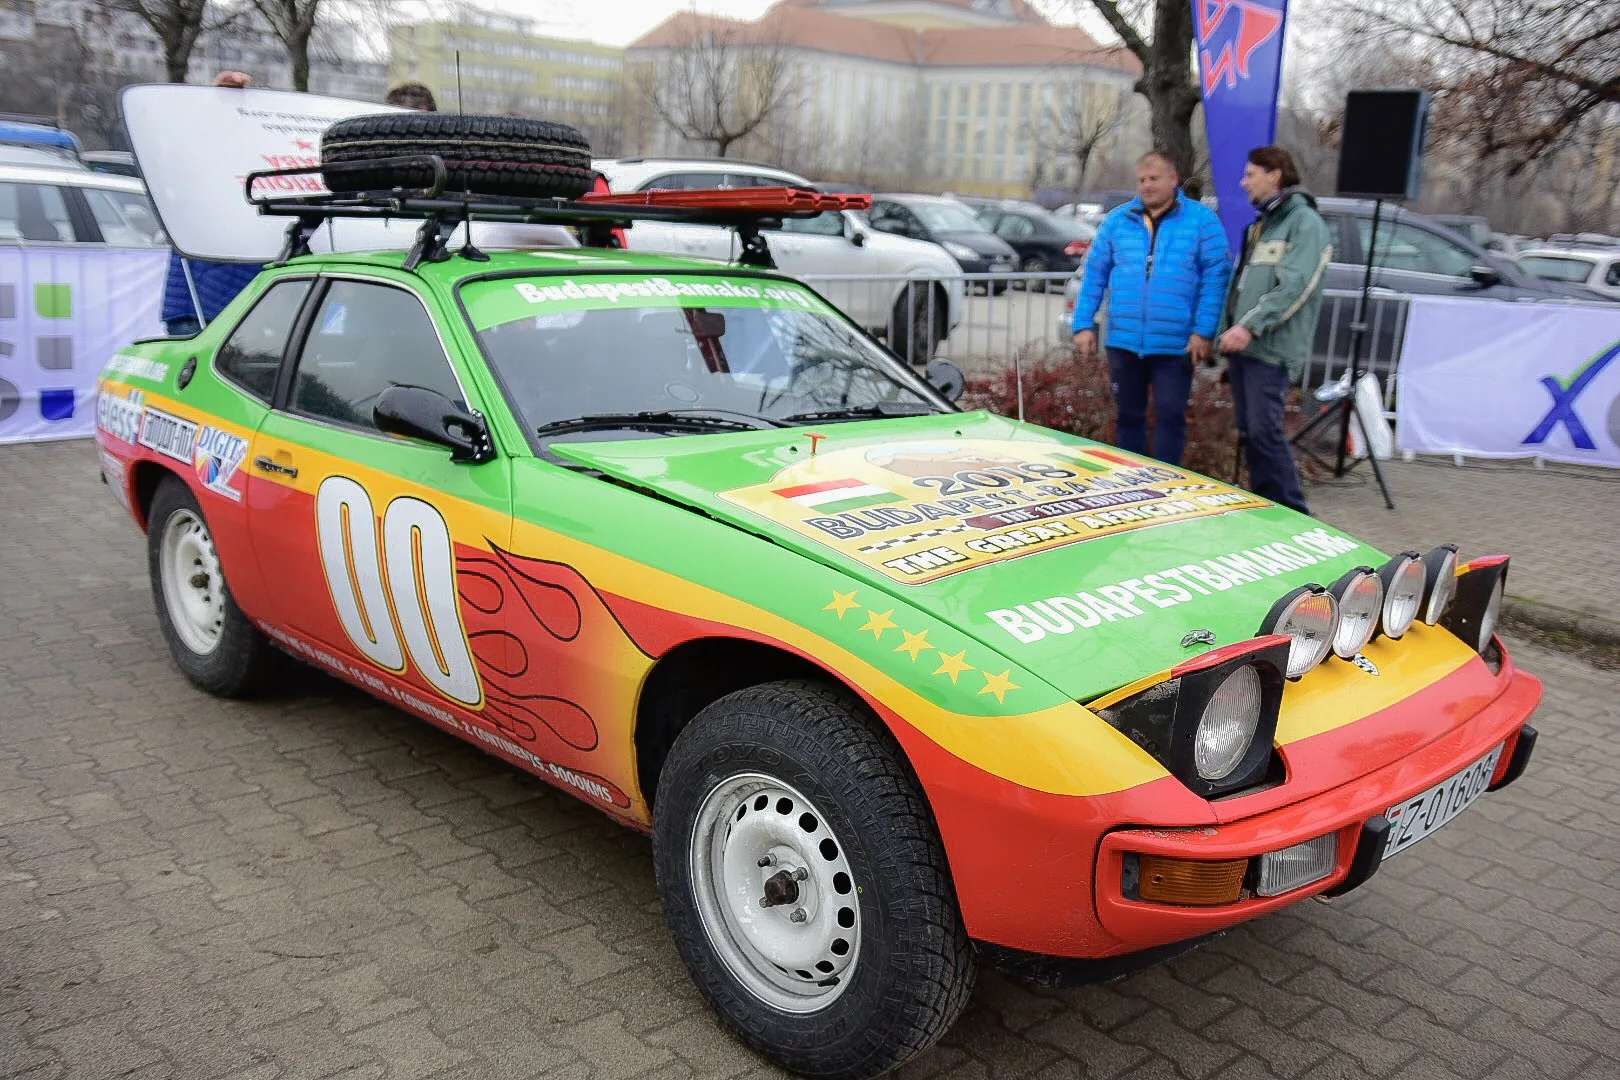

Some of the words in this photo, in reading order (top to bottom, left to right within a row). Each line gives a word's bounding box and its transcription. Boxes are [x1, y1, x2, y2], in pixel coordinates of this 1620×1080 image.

[514, 277, 811, 308] BudapestBamako.org
[911, 462, 1080, 498] 2018
[802, 465, 1188, 540] BUDAPEST-BAMAKO
[990, 506, 1039, 525] THE
[1035, 499, 1086, 516] 12TH
[882, 545, 972, 576] THE
[964, 520, 1080, 555] GREAT
[1072, 499, 1203, 530] AFRICAN
[314, 473, 486, 712] 00
[548, 763, 613, 803] 9000KMS
